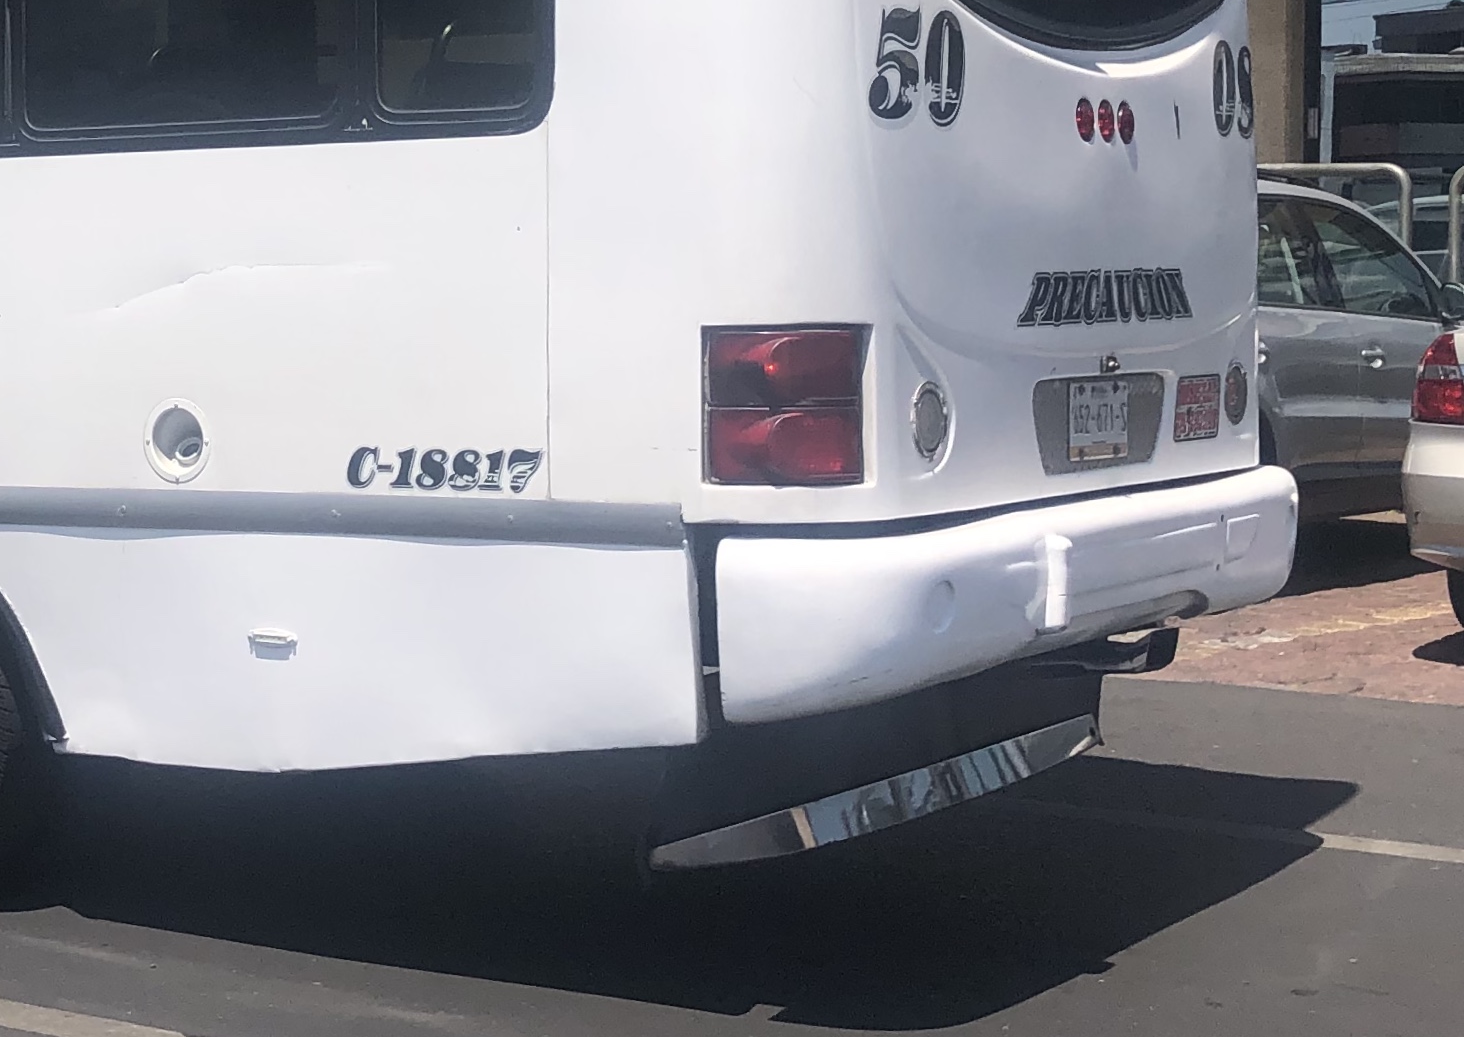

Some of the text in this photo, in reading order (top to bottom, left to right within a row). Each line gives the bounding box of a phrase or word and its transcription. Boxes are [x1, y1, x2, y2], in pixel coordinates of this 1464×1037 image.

[868, 5, 966, 128] 50
[1212, 39, 1254, 140] 08
[1016, 267, 1194, 328] PRECAUCION
[346, 445, 545, 495] C-18817
